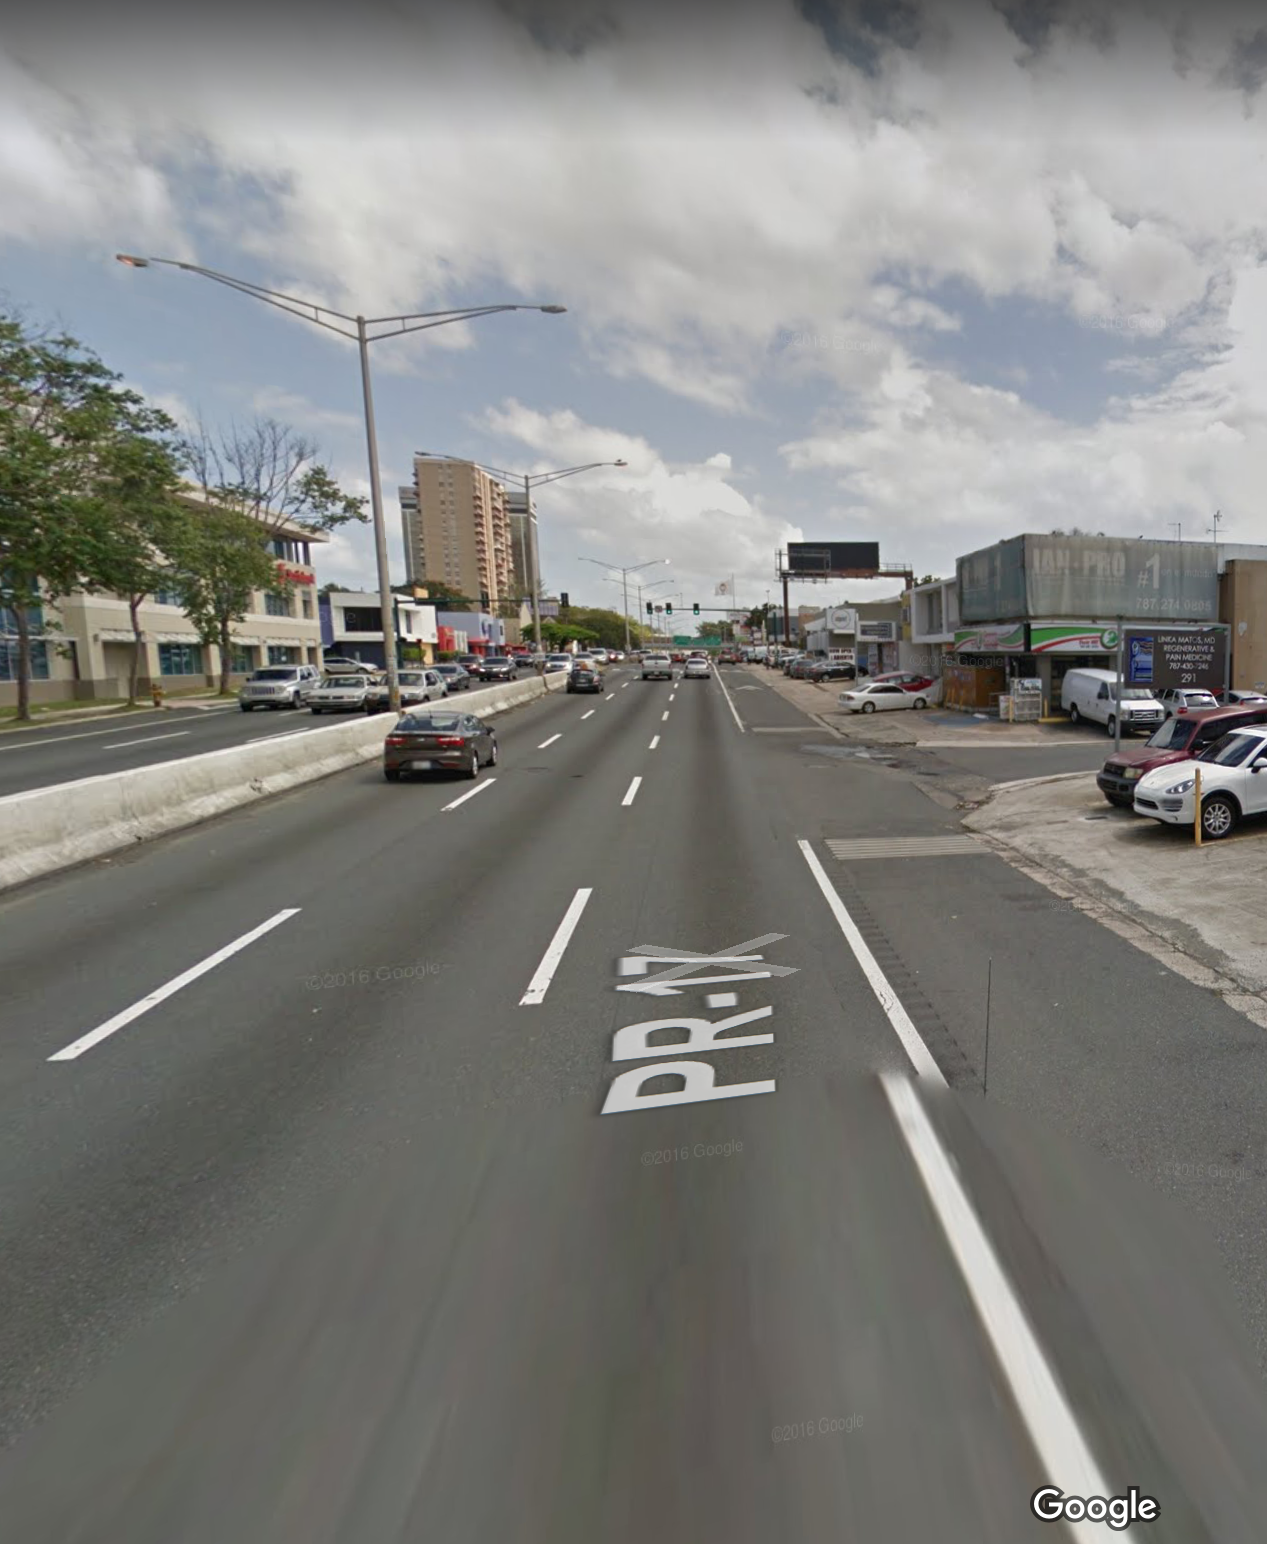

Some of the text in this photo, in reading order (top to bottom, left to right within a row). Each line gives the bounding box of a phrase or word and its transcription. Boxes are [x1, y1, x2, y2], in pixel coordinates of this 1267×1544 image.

[1137, 553, 1161, 590] #1
[1165, 653, 1213, 662] PAIN MEDICINE
[1181, 673, 1197, 683] 291
